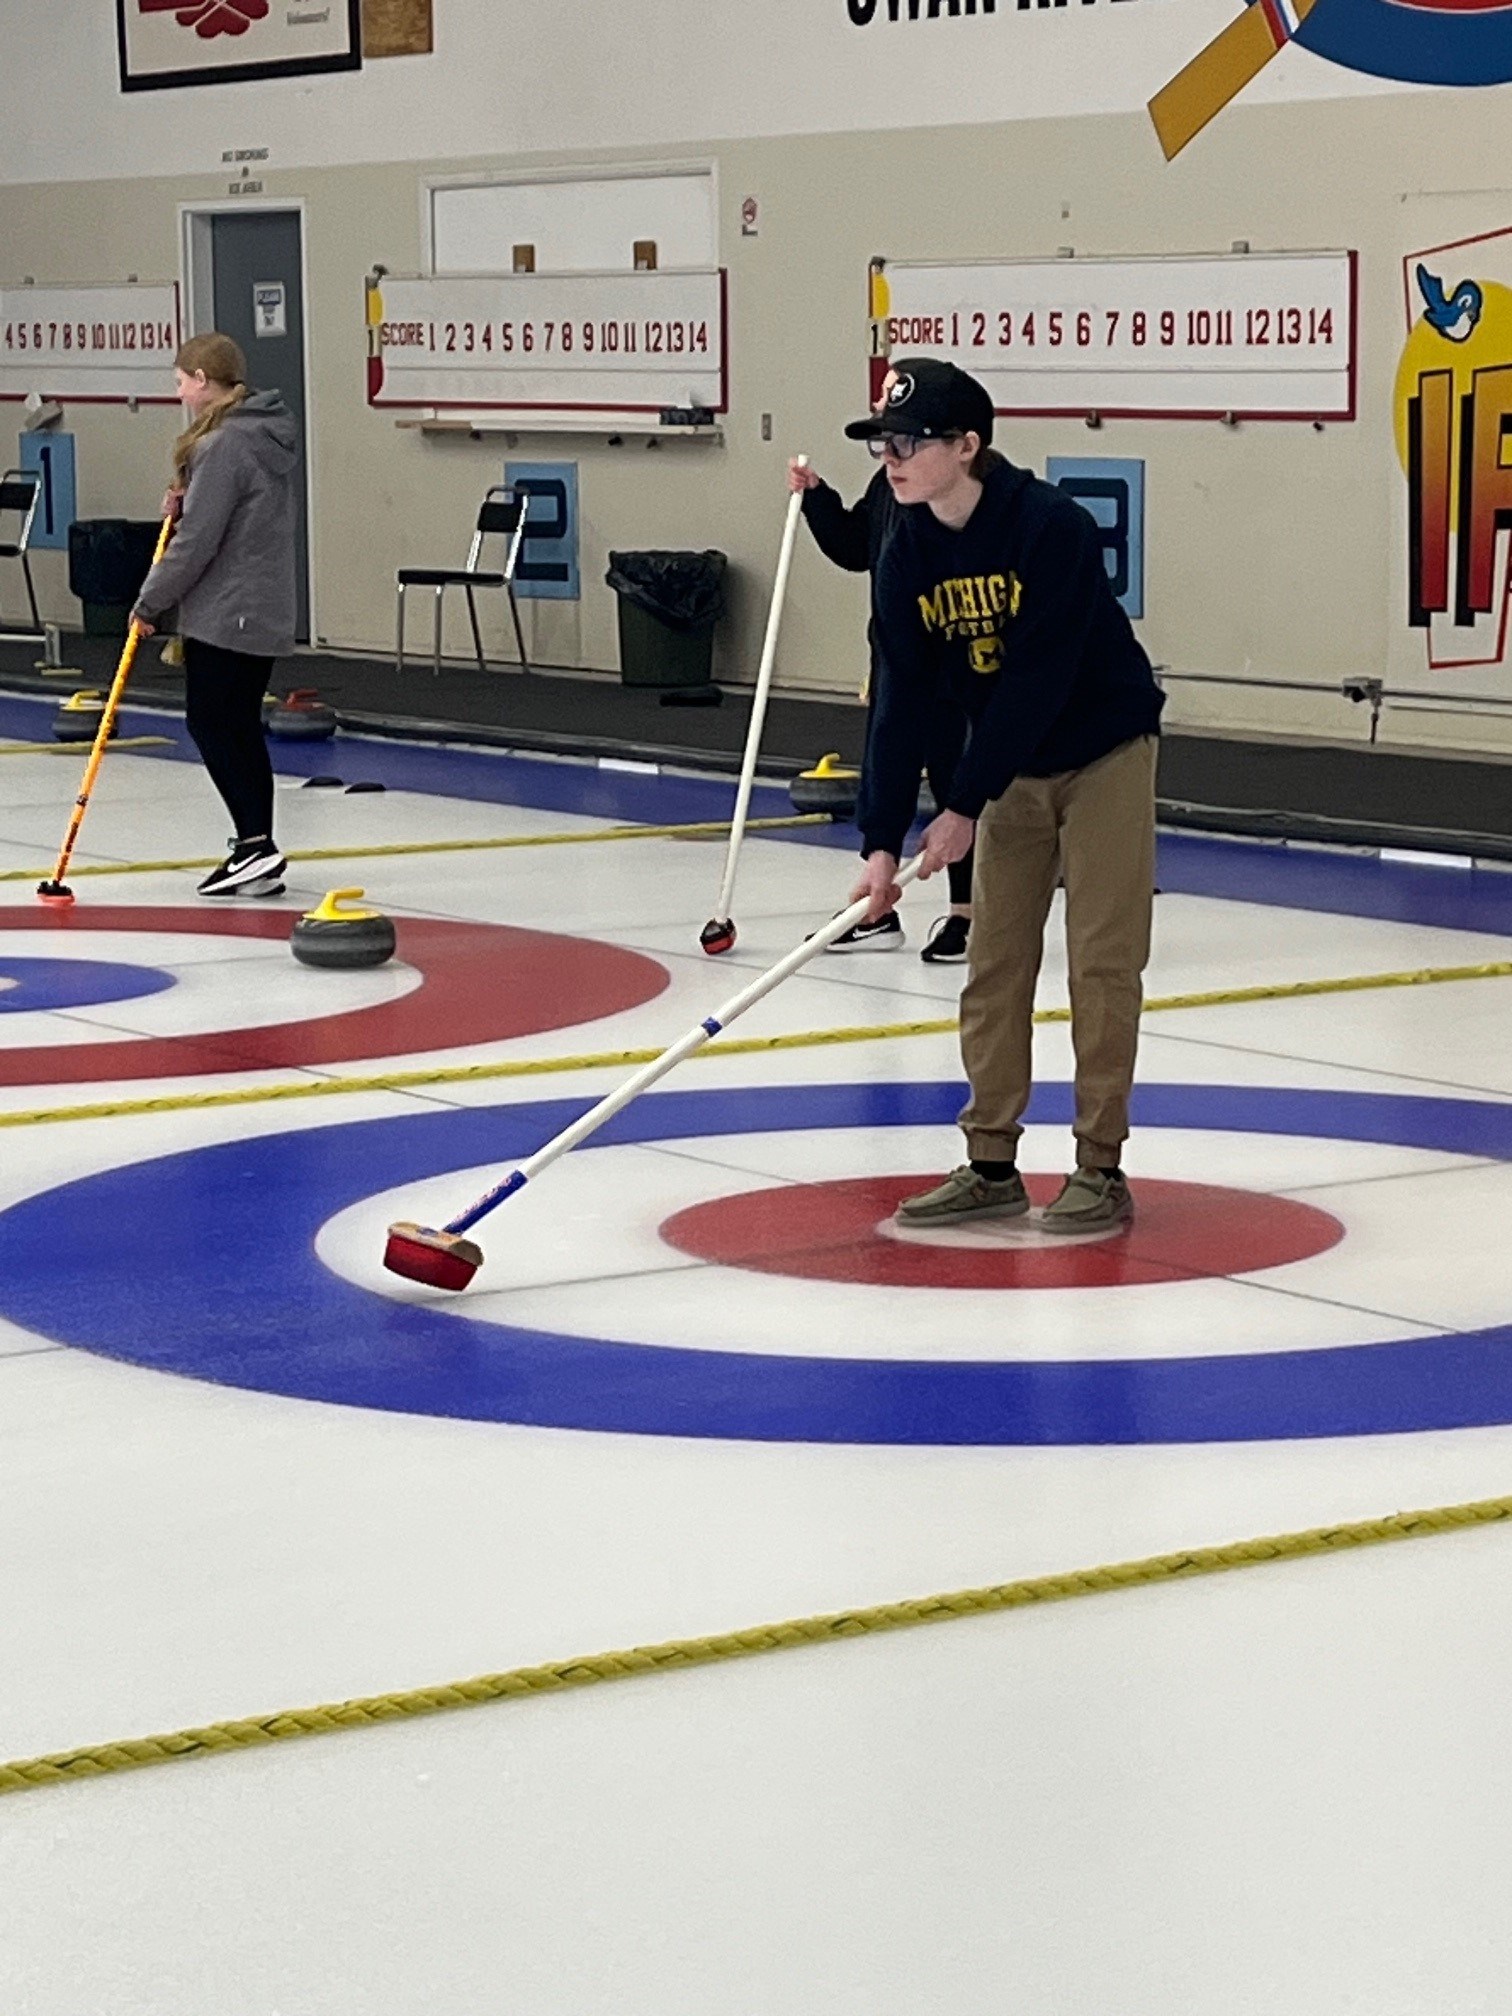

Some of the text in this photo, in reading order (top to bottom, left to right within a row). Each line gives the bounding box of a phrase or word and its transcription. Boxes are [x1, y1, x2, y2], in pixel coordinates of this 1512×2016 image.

[5, 322, 173, 350] 4 5 6 7 8 9 10 11 12 13 14
[381, 322, 708, 352] SCORE 1 2 3 4 5 6 7 8 9 10 11 12 13 14
[888, 308, 1333, 346] SCORE 1 2 3 4 5 6 7 8 9 10 11 12 13 14
[40, 446, 54, 535] 1
[514, 478, 568, 582] 2
